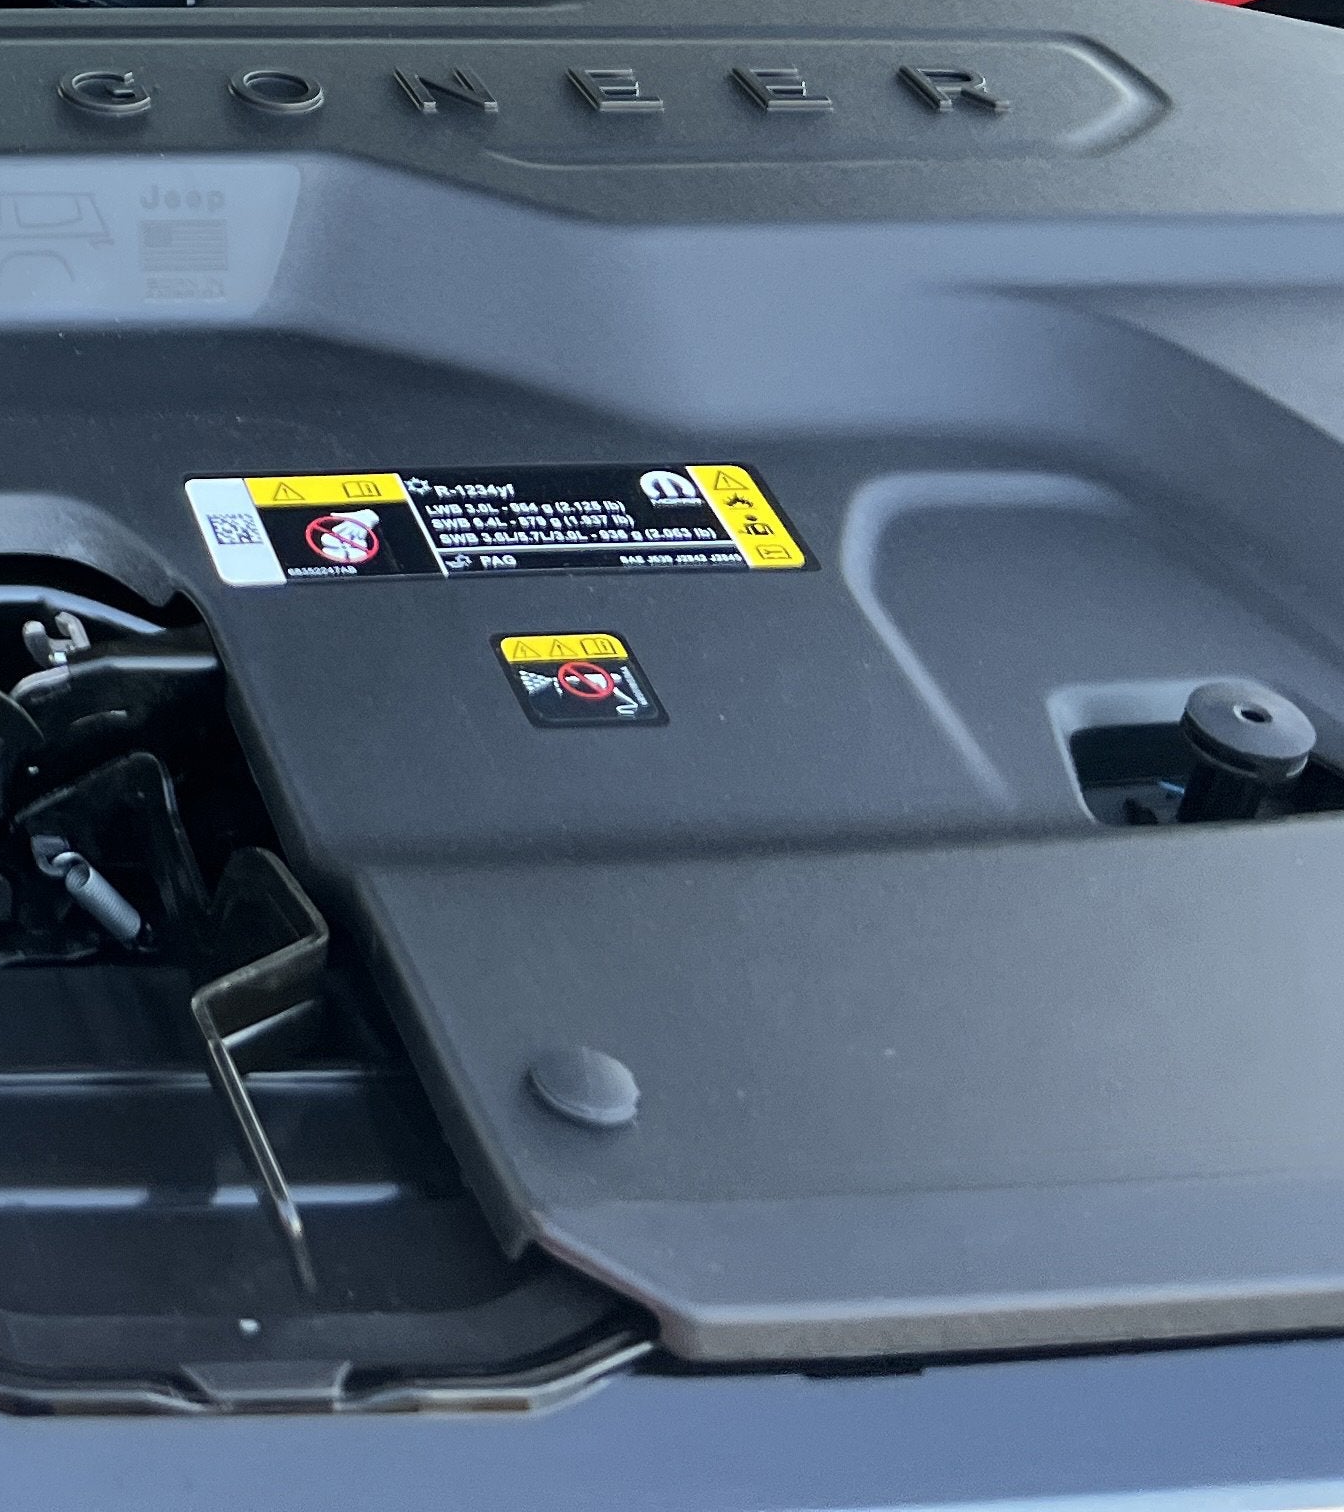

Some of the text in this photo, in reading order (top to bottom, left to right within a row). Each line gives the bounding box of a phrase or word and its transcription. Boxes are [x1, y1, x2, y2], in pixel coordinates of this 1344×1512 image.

[139, 184, 225, 213] Jeep
[433, 483, 515, 500] R-1234yf
[425, 504, 463, 516] LWB
[464, 503, 499, 515] 3.0L
[540, 503, 553, 516] g
[602, 500, 626, 514] lb)
[431, 517, 471, 530] SWB
[549, 517, 562, 530] g
[611, 514, 635, 529] lb)
[439, 532, 479, 546] SWB
[630, 530, 643, 543] g
[692, 527, 717, 541] lb)
[480, 554, 517, 569] PAG
